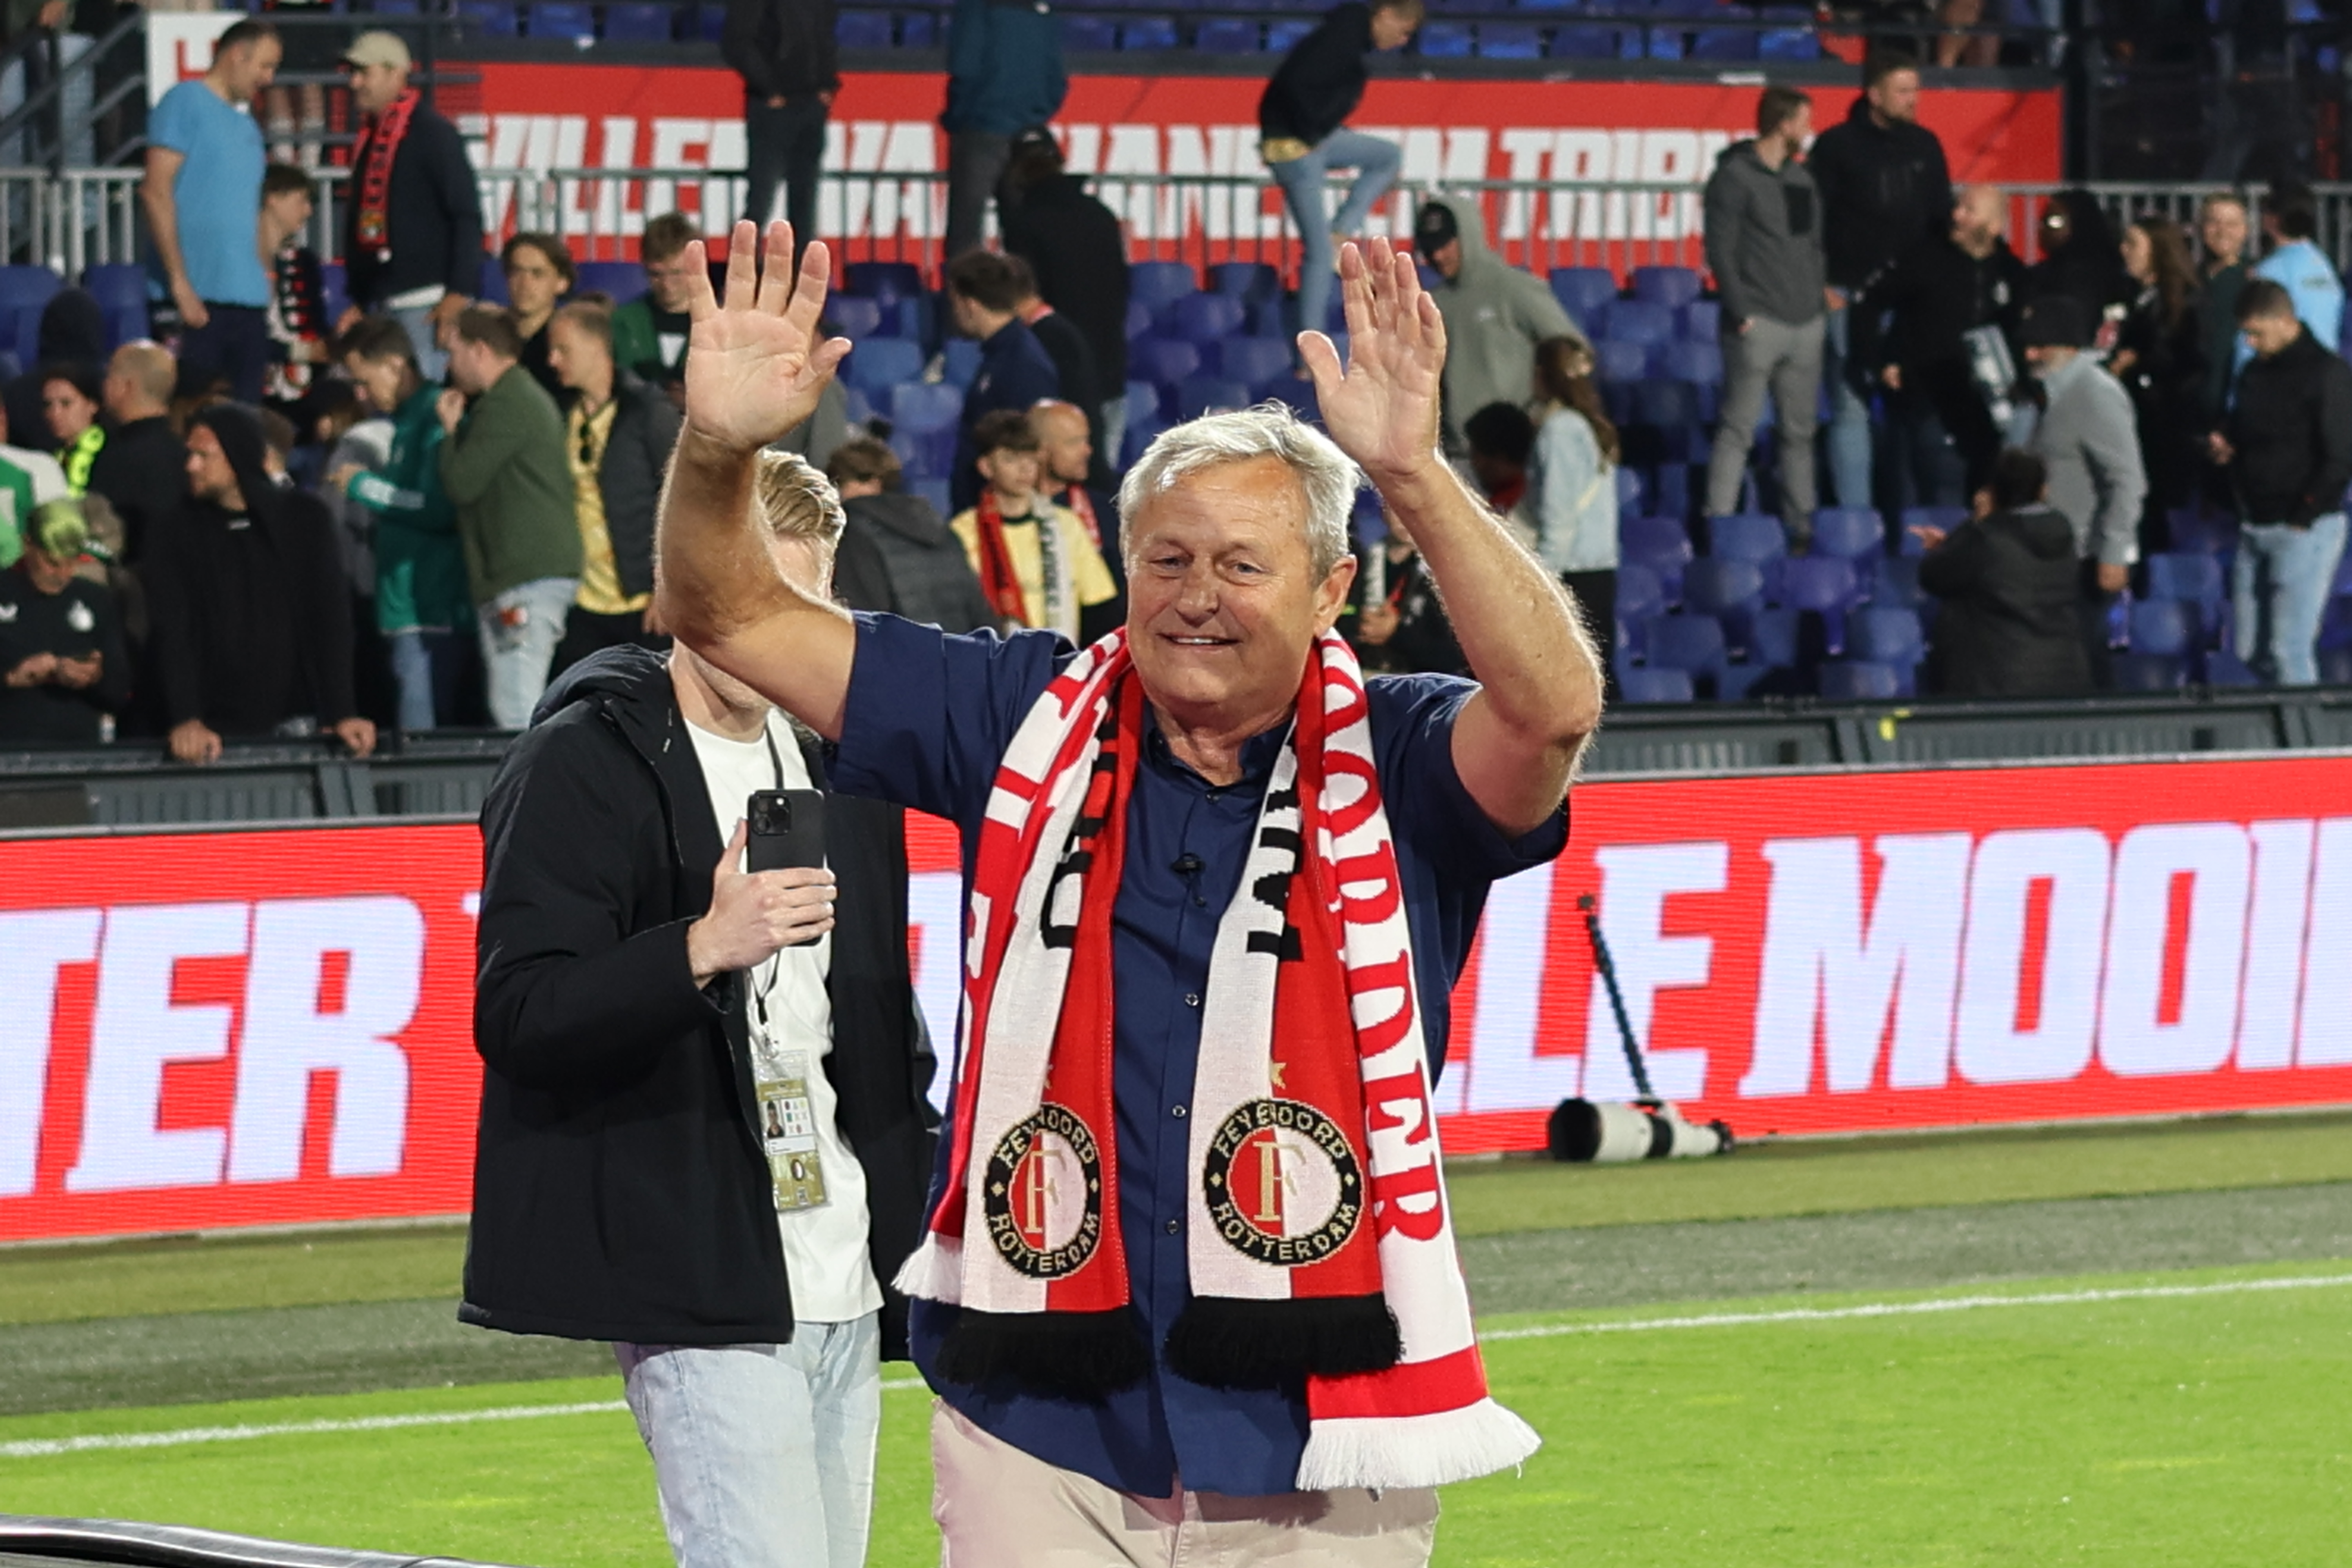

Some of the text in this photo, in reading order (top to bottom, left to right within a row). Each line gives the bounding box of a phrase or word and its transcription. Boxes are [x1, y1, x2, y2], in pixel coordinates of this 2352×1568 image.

[813, 121, 999, 238] VA
[1499, 128, 1817, 240] TRIB
[1318, 638, 1445, 1243] OORDER
[1433, 841, 1730, 1114] LE
[996, 1109, 1096, 1166] FEYOORD
[989, 1212, 1099, 1272] ROTTERDAM
[1213, 1201, 1356, 1260] ROTTERDAM
